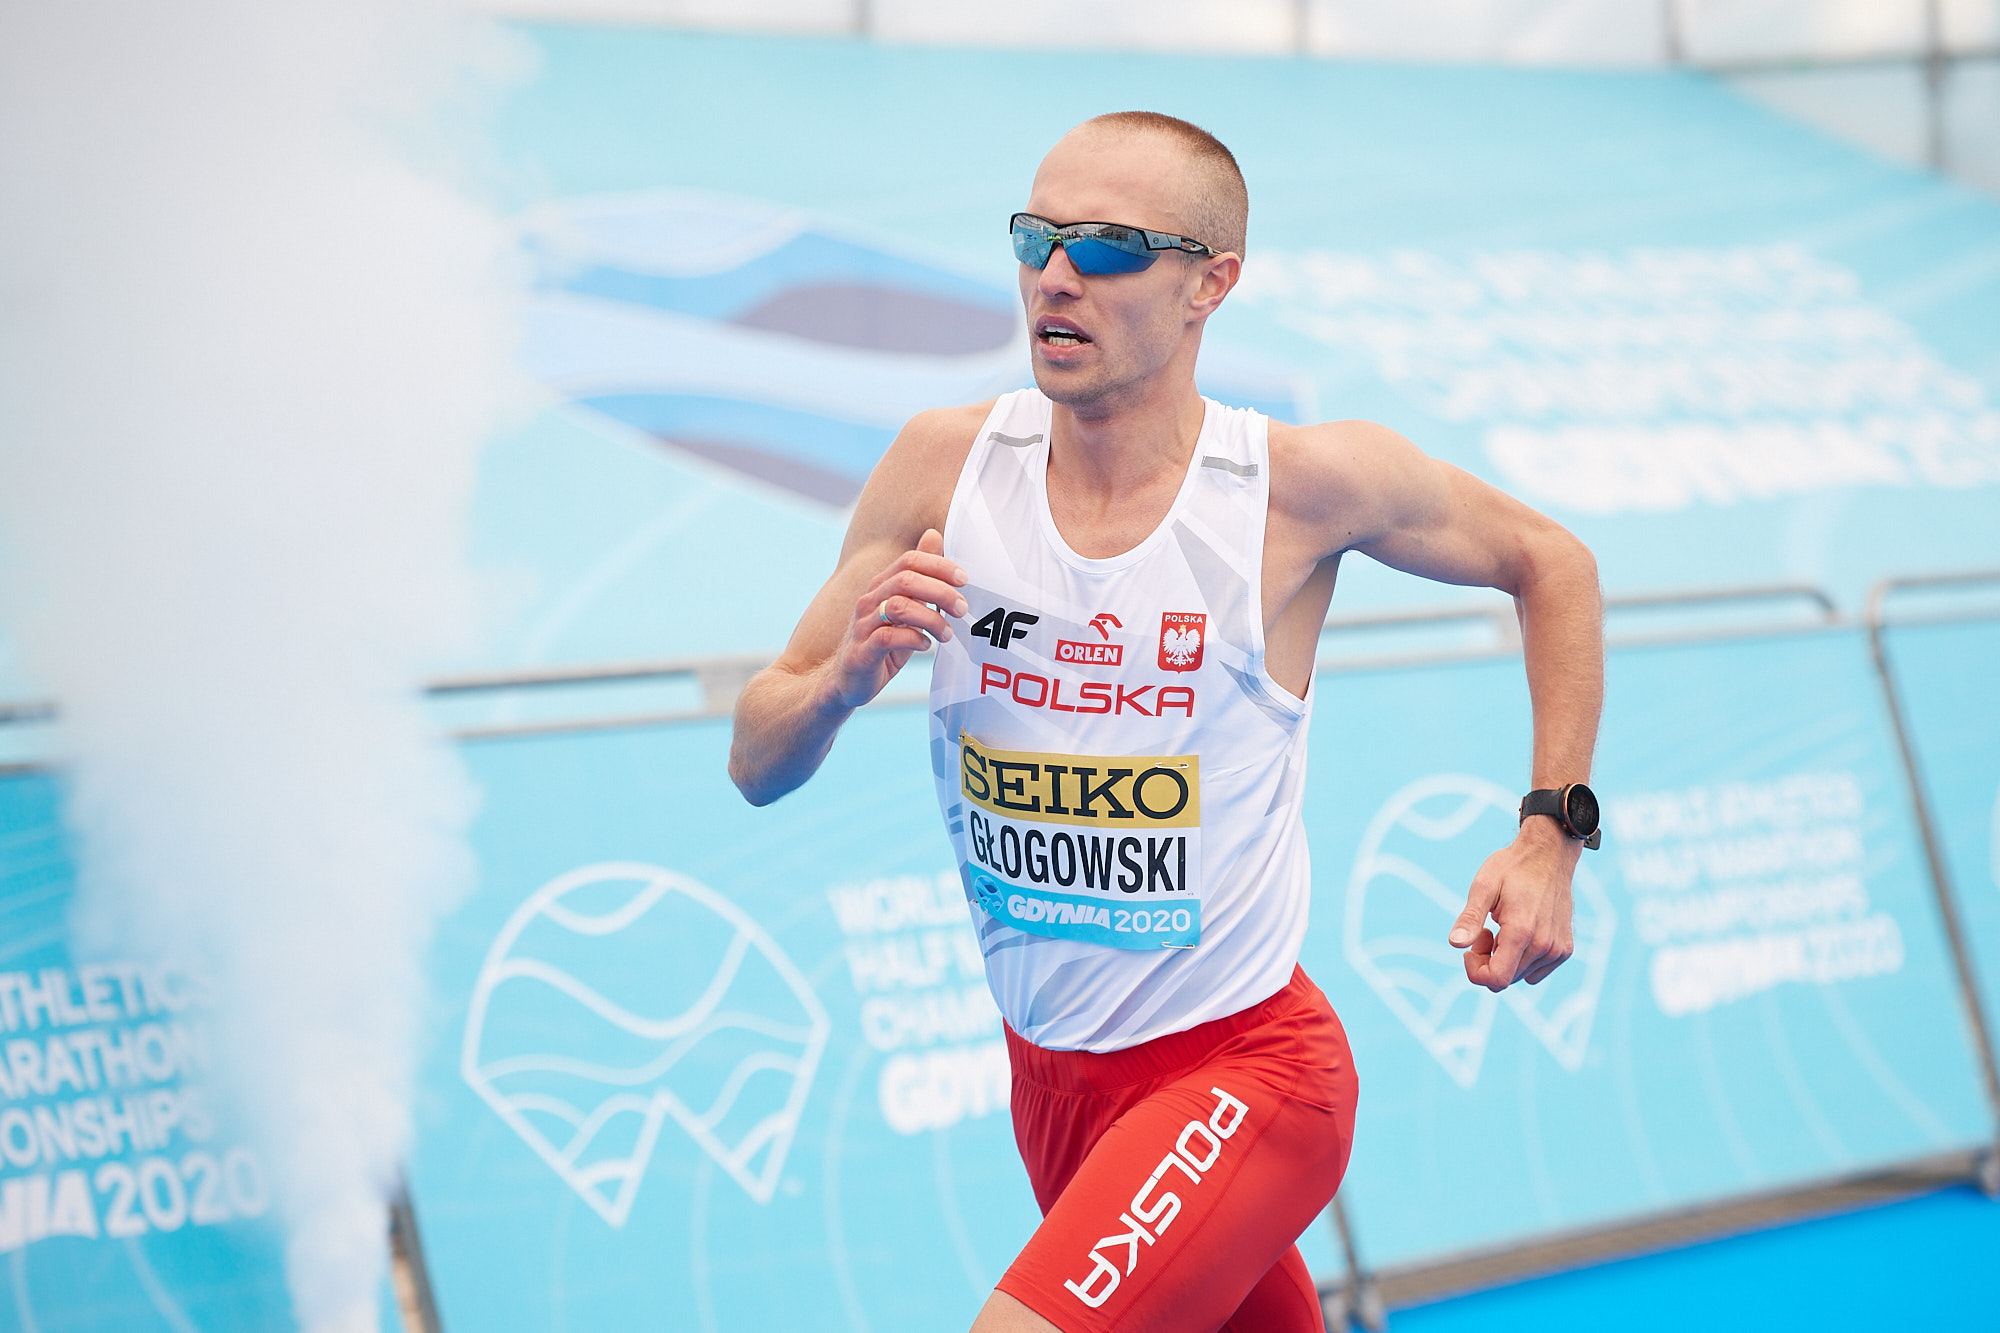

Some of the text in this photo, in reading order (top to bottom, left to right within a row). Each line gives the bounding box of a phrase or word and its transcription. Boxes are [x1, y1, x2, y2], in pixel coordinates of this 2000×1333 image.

[970, 607, 1040, 650] 4F
[1060, 643, 1119, 663] ORLEN
[1165, 615, 1203, 624] POLSKA
[980, 662, 1195, 718] POLSKA
[963, 745, 1189, 820] SEIKO
[970, 810, 1186, 894] GŁOGOWSKI
[1007, 894, 1191, 934] GDYNIA 2020
[0, 960, 215, 1031] THLETICS
[0, 1086, 216, 1170] ONSHIPS
[95, 1147, 268, 1237] 2020
[1063, 1086, 1250, 1308] POLSKA
